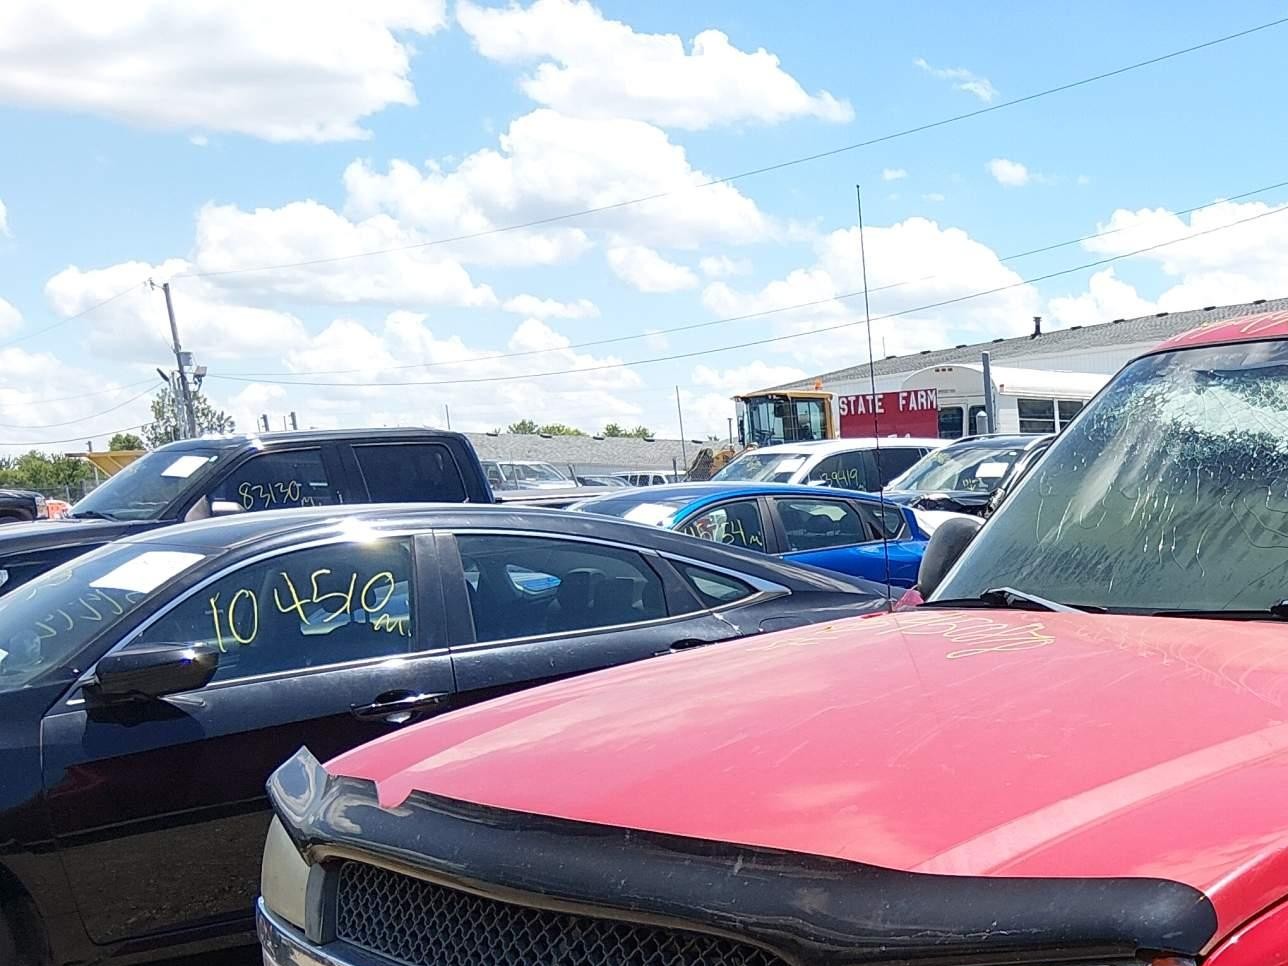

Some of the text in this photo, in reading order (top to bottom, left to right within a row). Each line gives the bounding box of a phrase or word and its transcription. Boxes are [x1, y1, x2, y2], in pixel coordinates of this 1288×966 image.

[840, 389, 936, 415] STATE FARM
[239, 480, 300, 510] 83130
